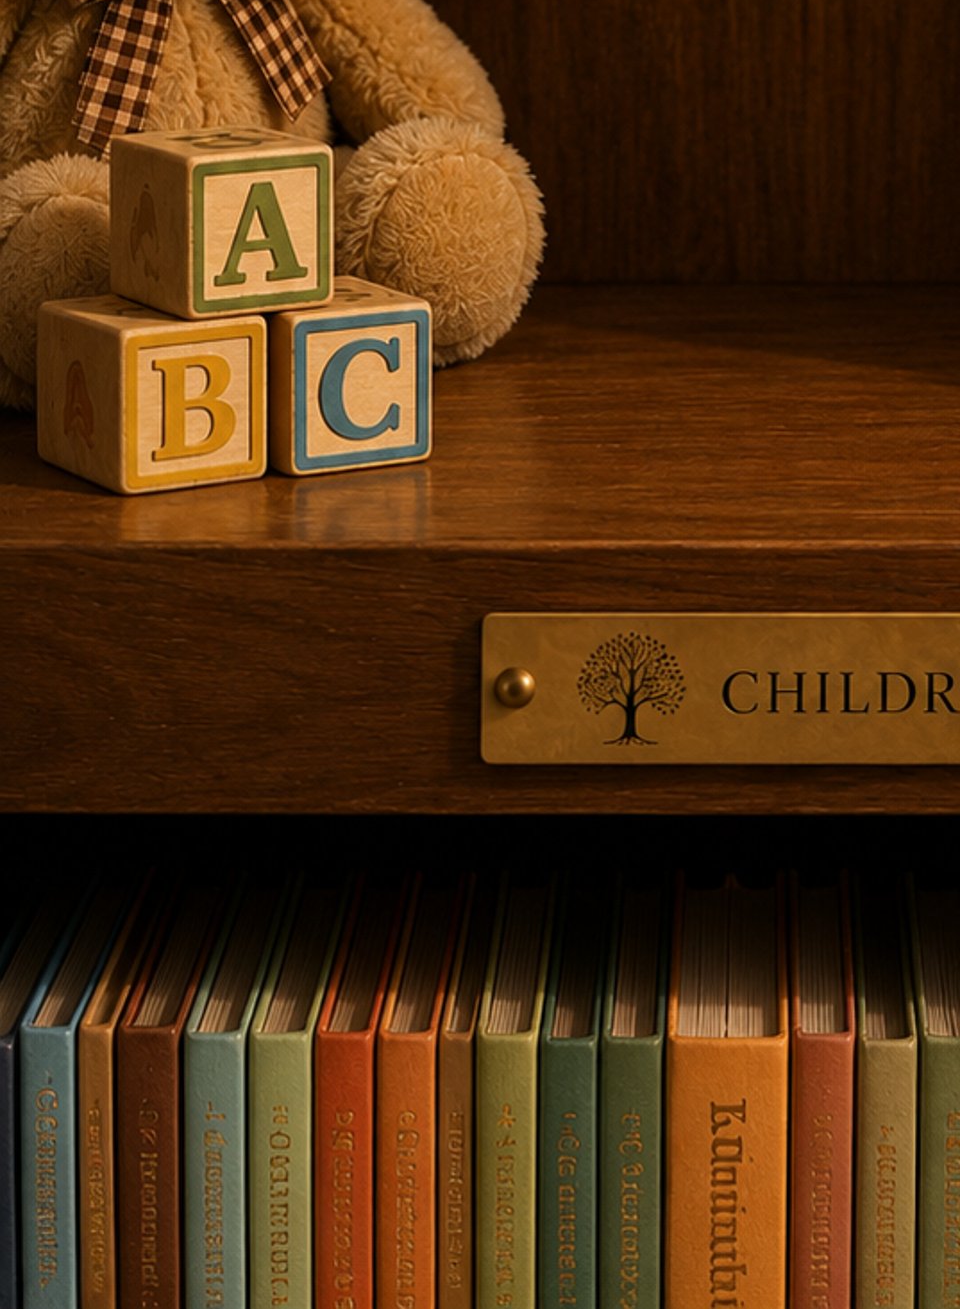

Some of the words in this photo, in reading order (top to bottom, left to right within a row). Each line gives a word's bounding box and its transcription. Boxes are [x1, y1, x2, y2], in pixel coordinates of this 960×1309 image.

[213, 181, 309, 287] A
[151, 353, 237, 463] B
[317, 336, 401, 442] C
